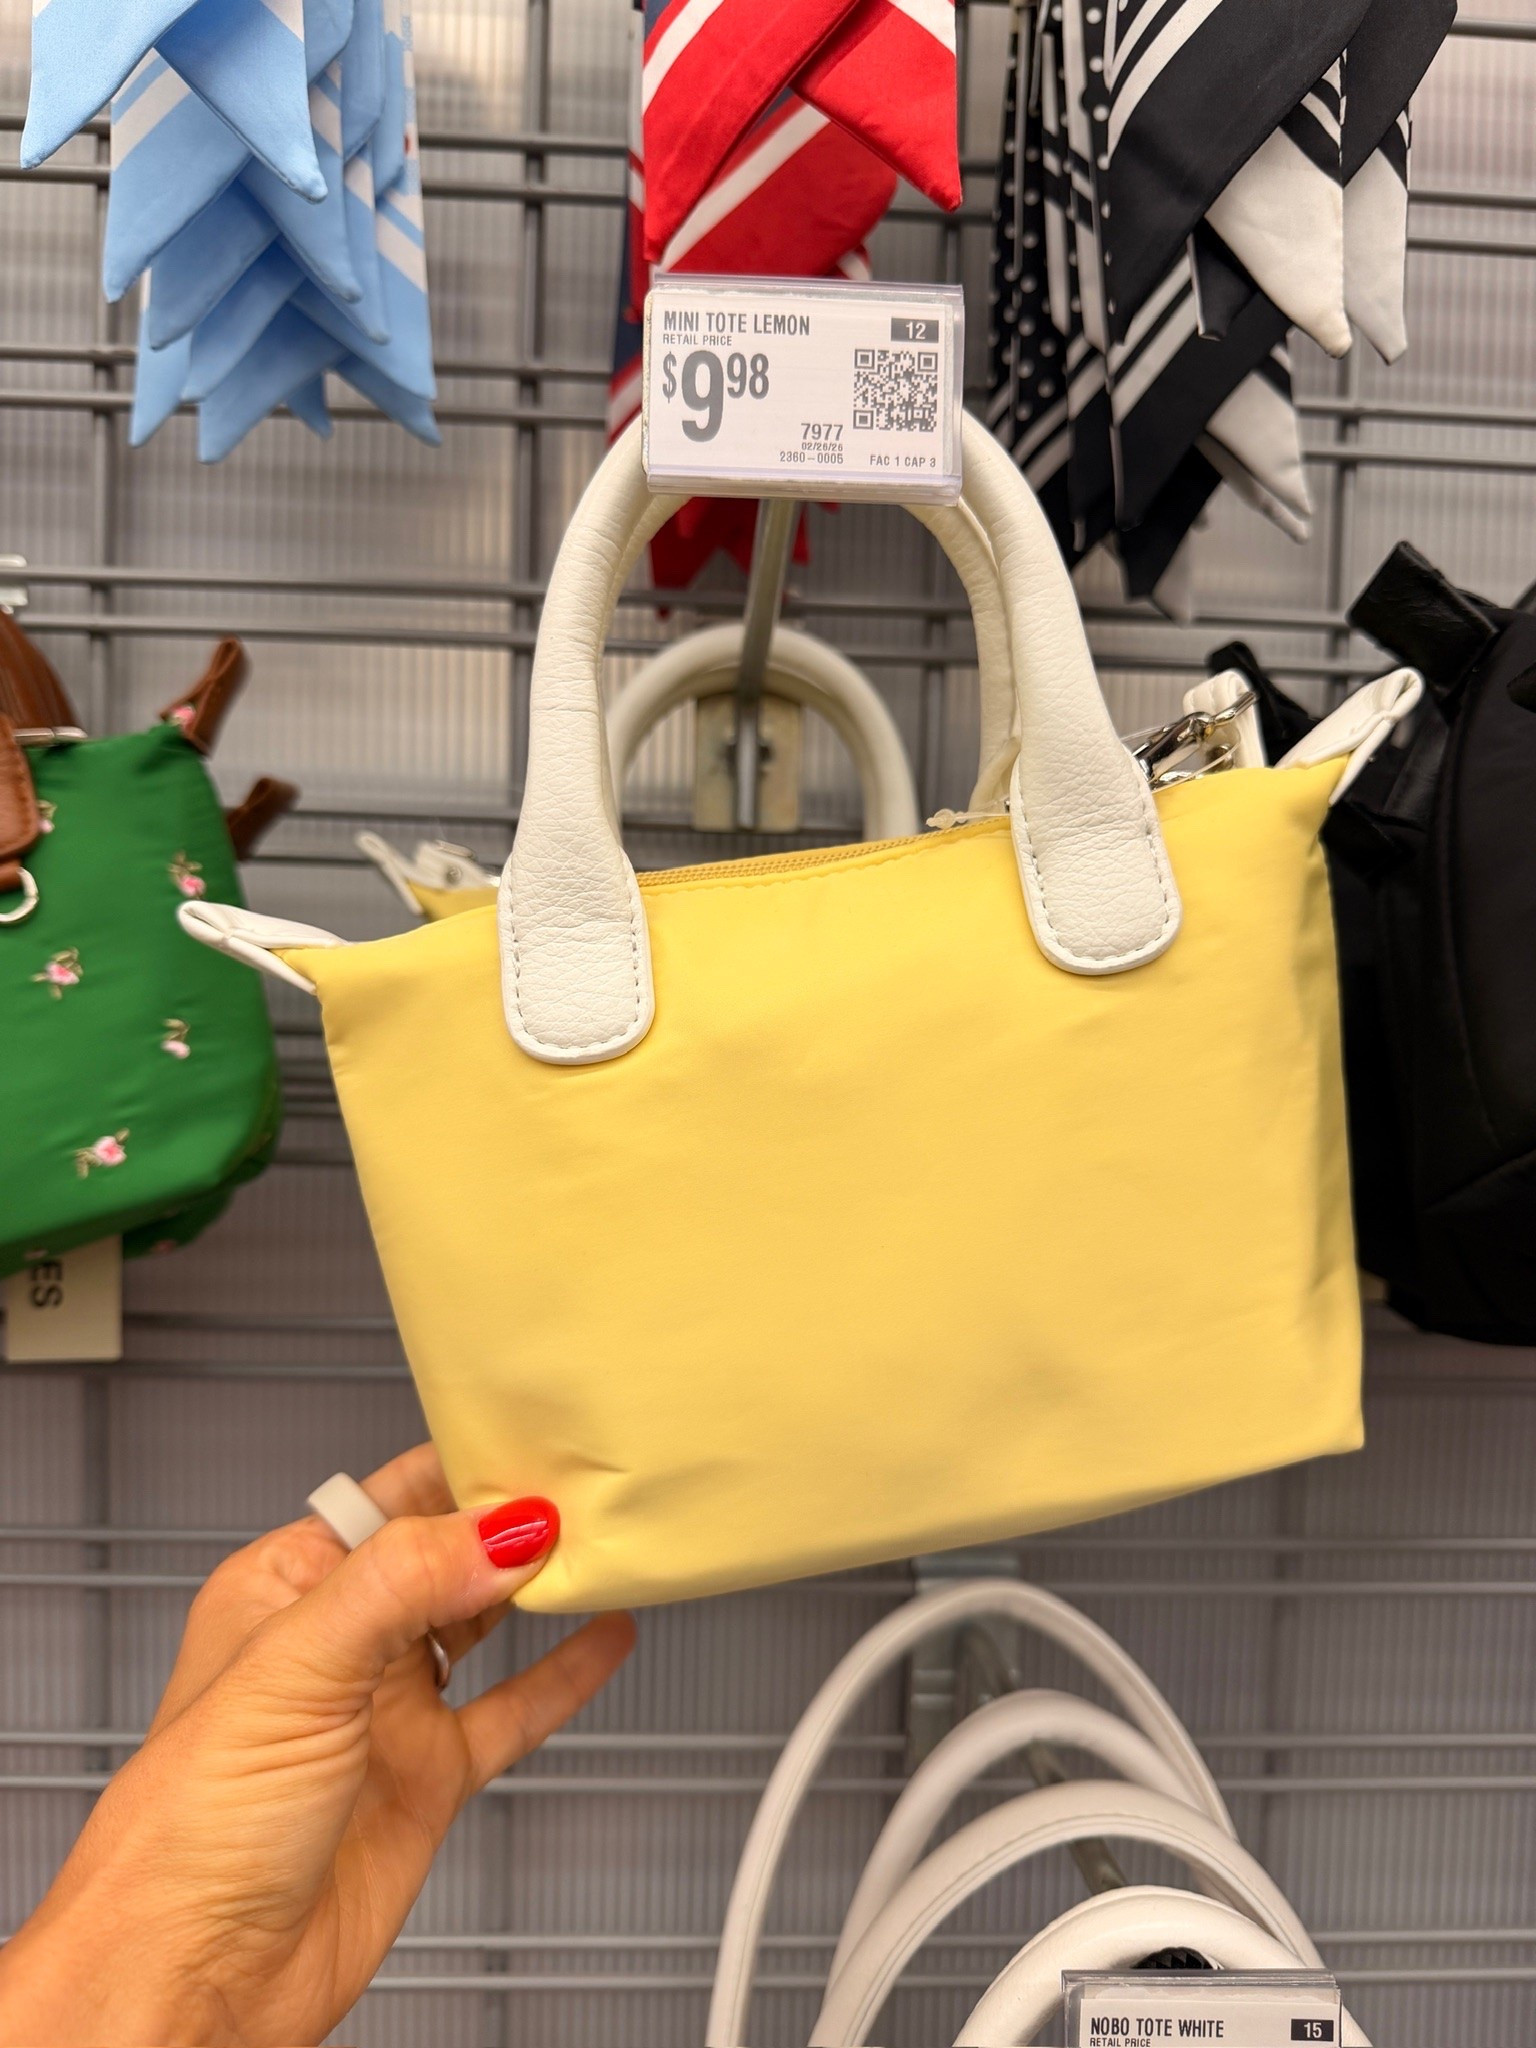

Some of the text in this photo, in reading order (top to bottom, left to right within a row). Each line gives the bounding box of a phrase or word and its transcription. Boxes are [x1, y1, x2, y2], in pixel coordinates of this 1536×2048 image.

[663, 310, 811, 336] MINI TOTE LEMON
[905, 322, 927, 340] 12
[662, 333, 732, 347] RETAIL PRICE
[801, 423, 844, 442] 7977
[869, 454, 890, 466] FAC
[904, 457, 926, 467] CAP
[929, 458, 936, 468] 3
[1090, 2017, 1225, 2038] NOBO TOTE WHITE
[1303, 2022, 1323, 2039] 15
[1090, 2037, 1152, 2048] RETAIL PRICE
